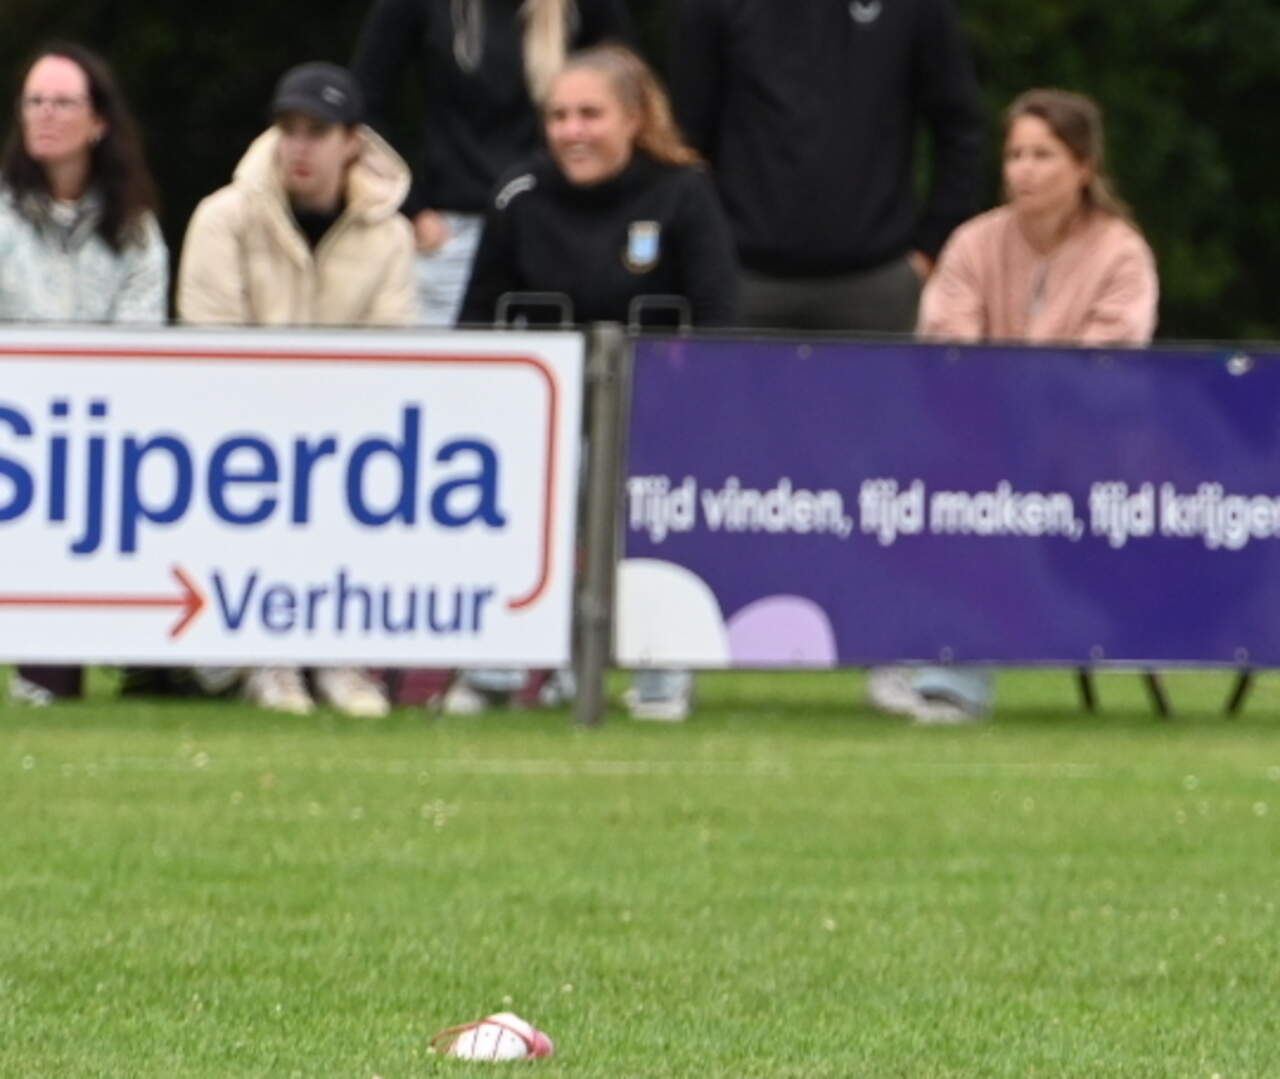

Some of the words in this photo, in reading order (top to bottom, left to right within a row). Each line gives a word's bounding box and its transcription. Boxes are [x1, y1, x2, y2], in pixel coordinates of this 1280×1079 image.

[0, 397, 507, 556] Sijperda
[627, 474, 697, 543] Tijd
[702, 475, 854, 540] vinden,
[859, 478, 925, 546] tijd
[930, 478, 1085, 543] maken,
[1088, 481, 1155, 549] tijd
[211, 568, 494, 635] Verhuur
